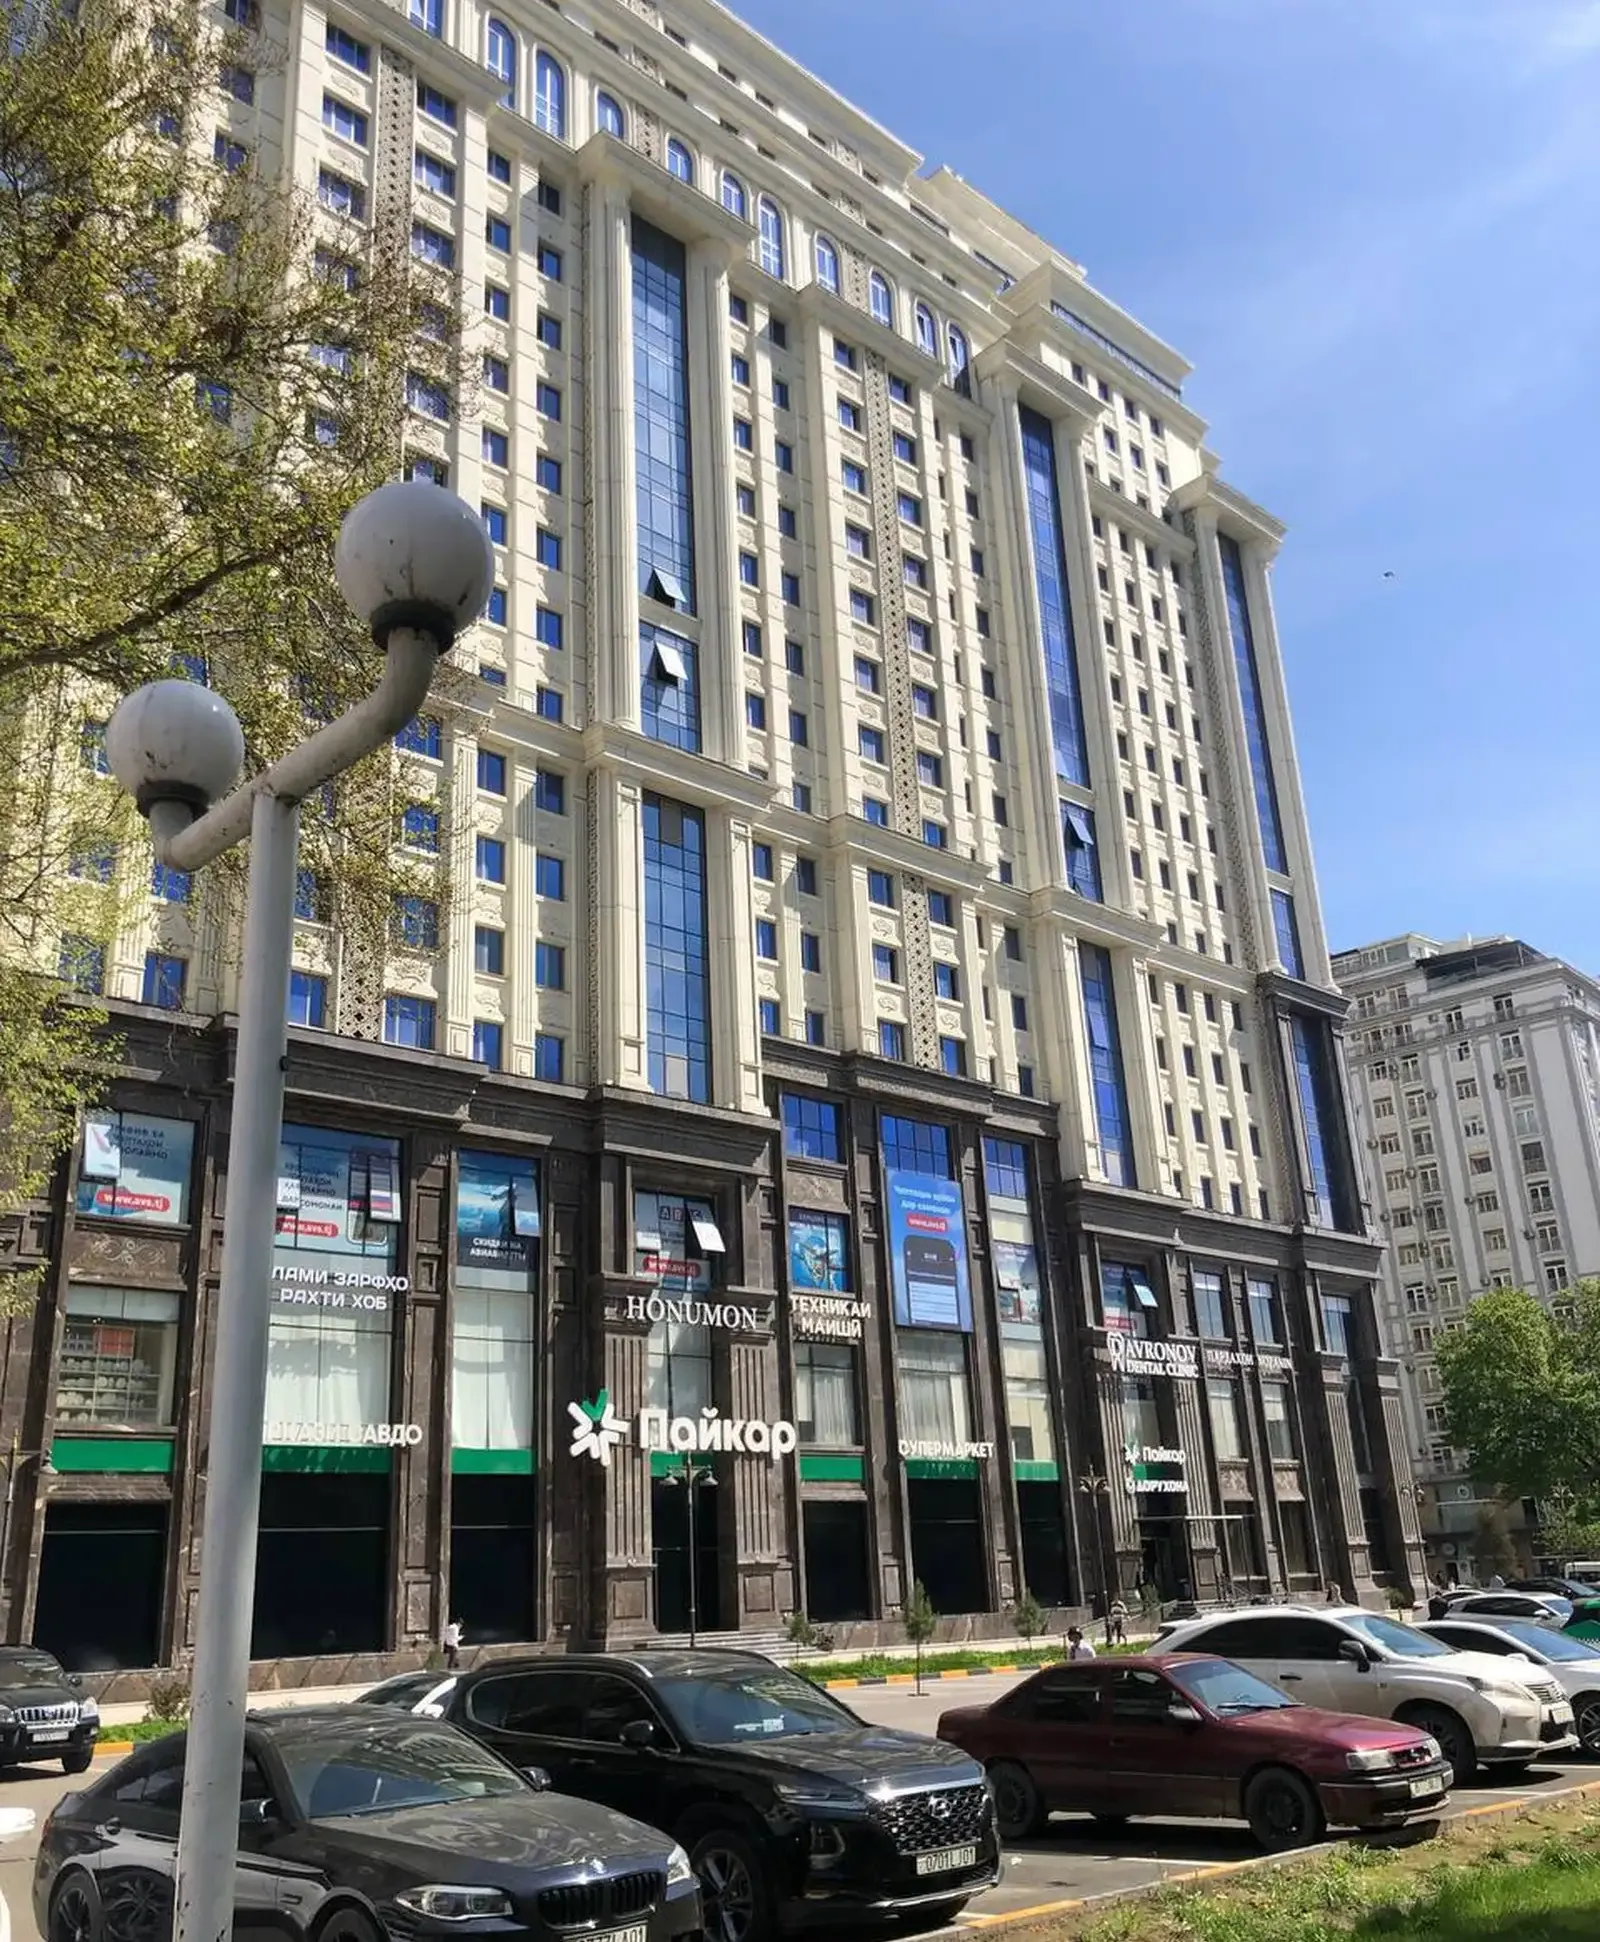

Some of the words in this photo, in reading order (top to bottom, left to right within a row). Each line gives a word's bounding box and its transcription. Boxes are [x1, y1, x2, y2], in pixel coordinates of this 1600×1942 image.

[280, 1287, 345, 1307] РАХТИ
[351, 1294, 388, 1311] ХОБ
[789, 1294, 872, 1319] ТЕХНИКАИ
[626, 1295, 758, 1330] HONUMON
[1126, 1358, 1166, 1376] DENTAL
[1165, 1361, 1200, 1378] CLINIC
[638, 1406, 797, 1461] Пайкар
